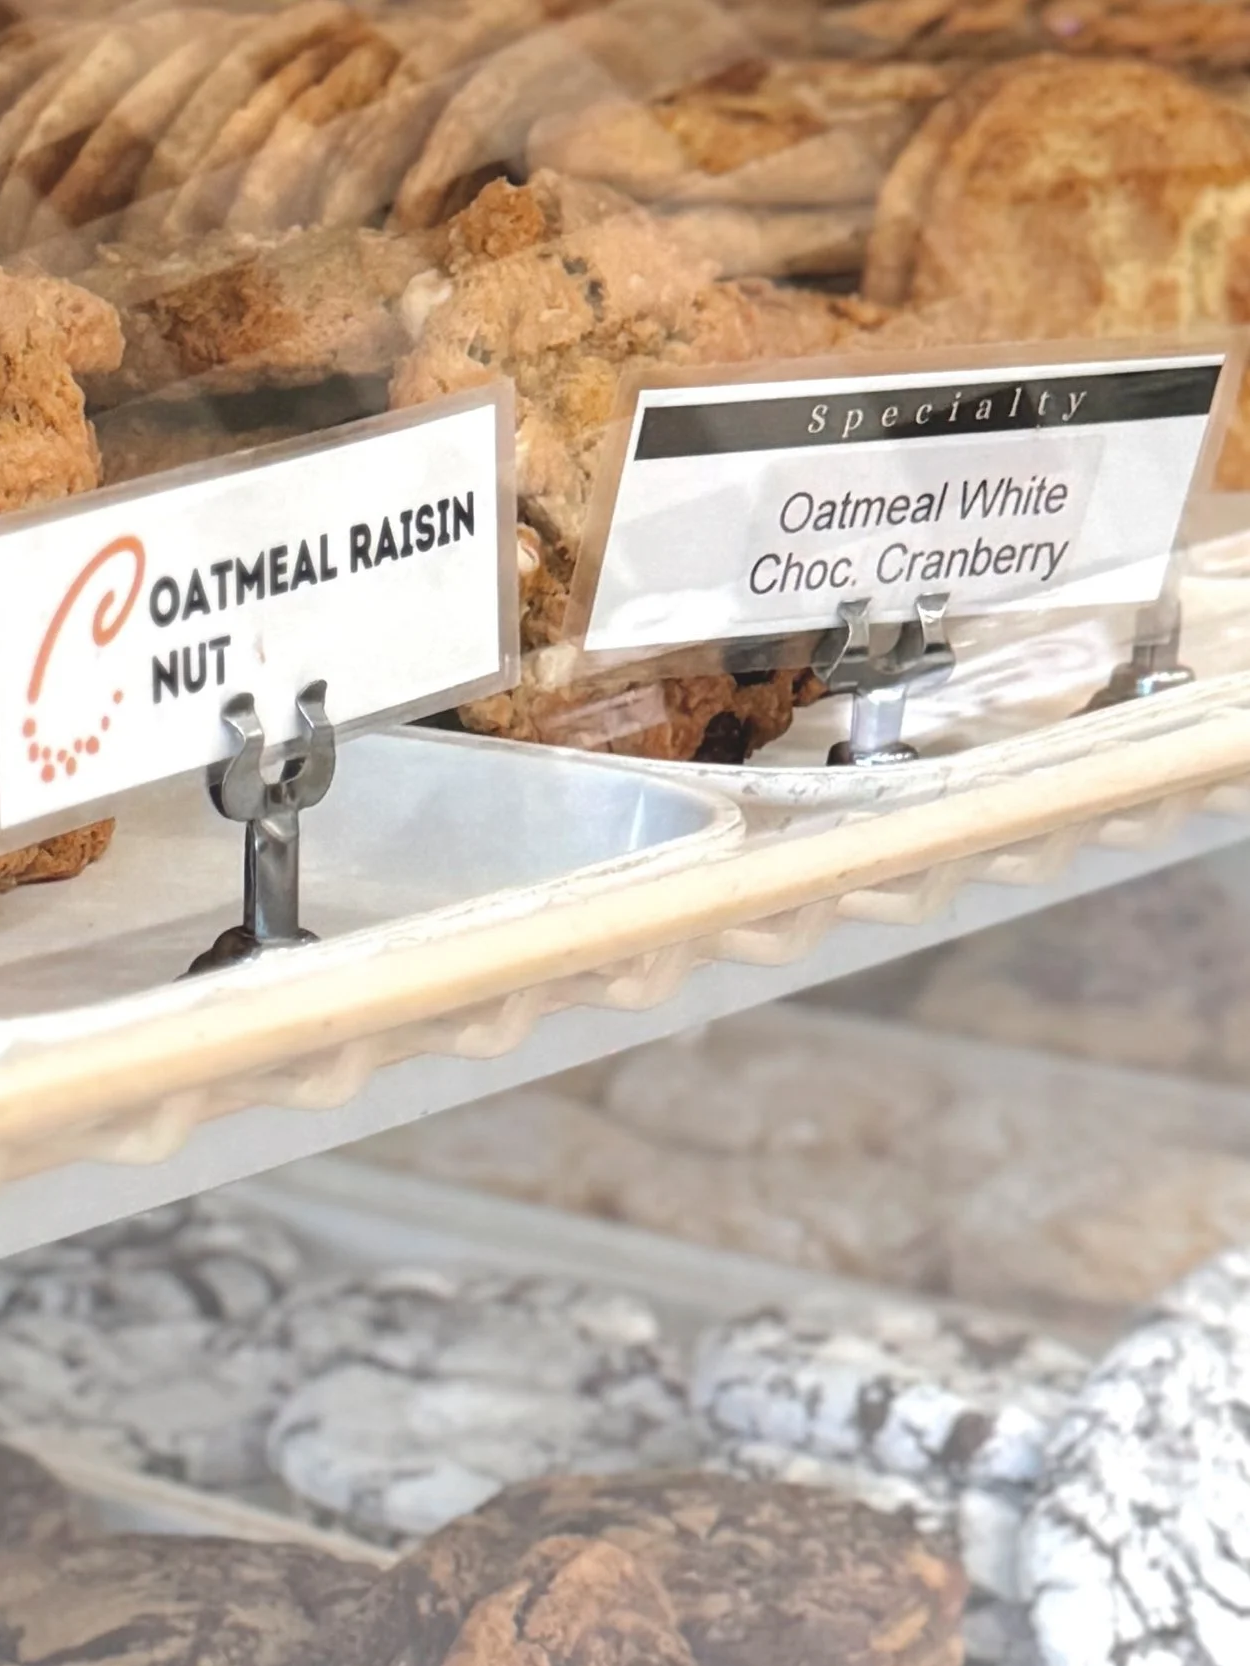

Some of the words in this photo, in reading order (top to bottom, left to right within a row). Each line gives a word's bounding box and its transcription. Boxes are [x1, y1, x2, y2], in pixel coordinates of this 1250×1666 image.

[807, 387, 1088, 438] Specialty
[779, 482, 948, 534] Oatmeal
[960, 475, 1068, 519] White
[149, 533, 338, 628] OATMEAL
[349, 491, 476, 574] RAISIN
[749, 552, 857, 595] Choc.
[876, 537, 1069, 584] Cranberry
[151, 635, 232, 704] NUT
